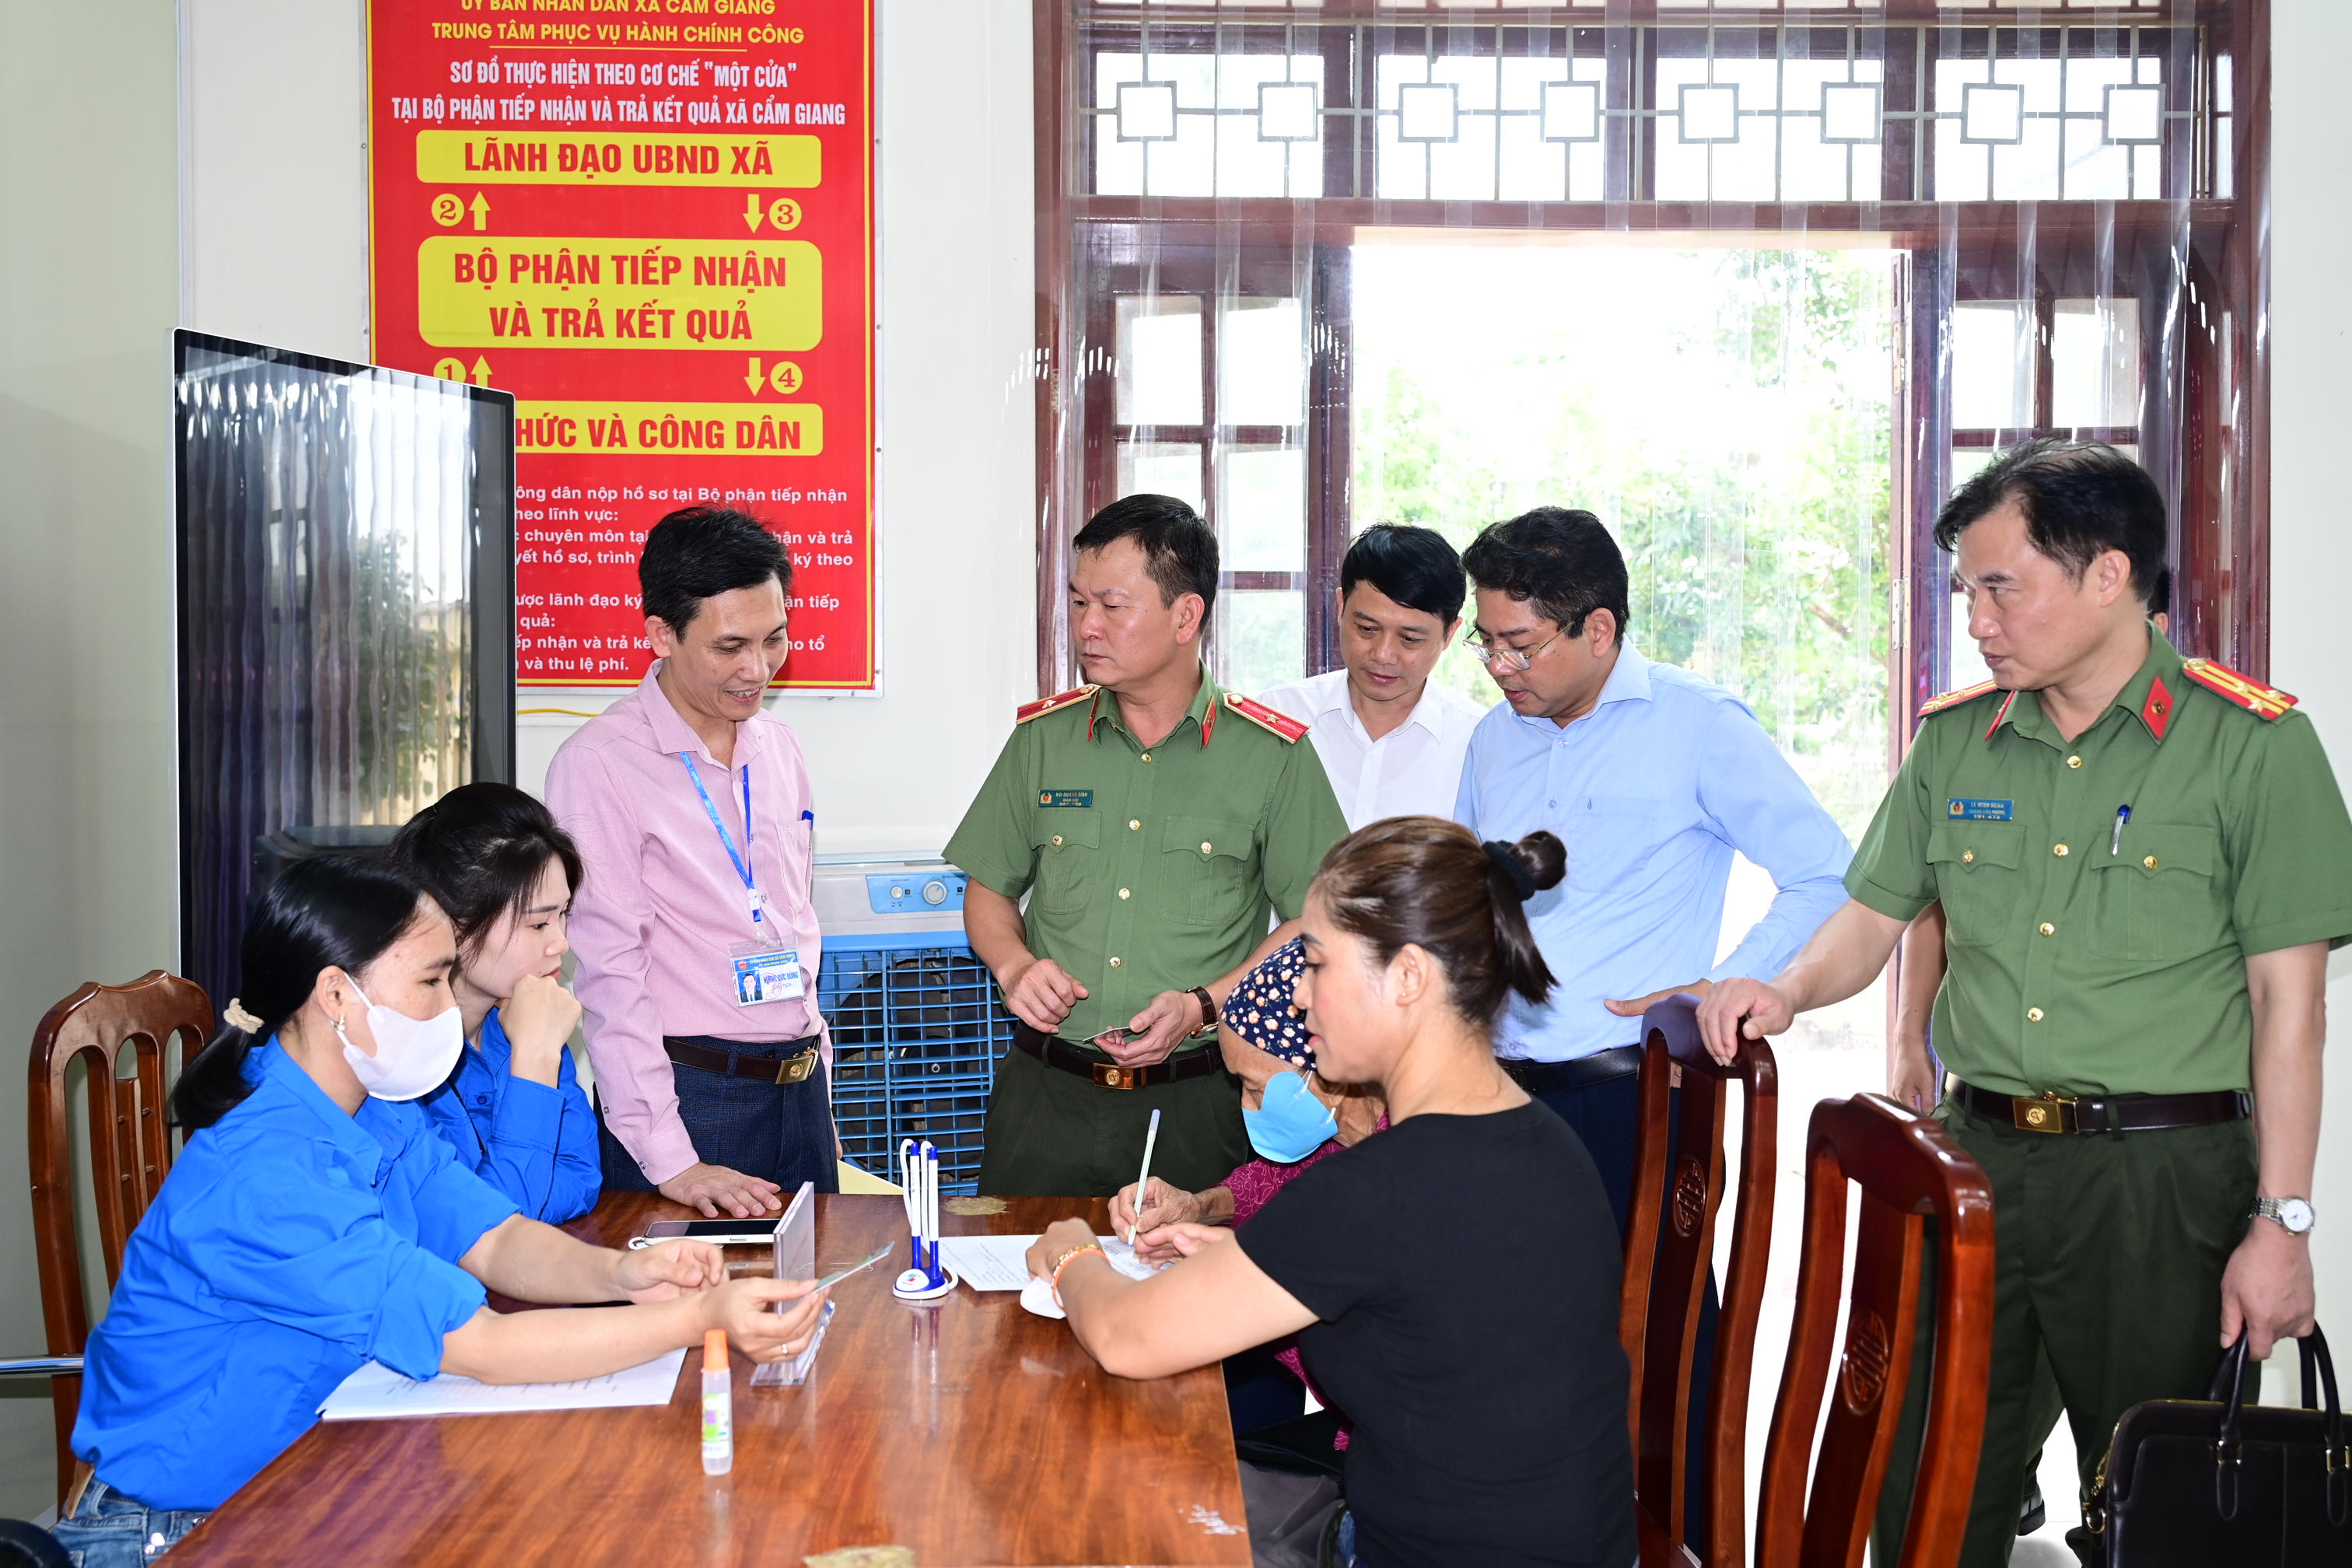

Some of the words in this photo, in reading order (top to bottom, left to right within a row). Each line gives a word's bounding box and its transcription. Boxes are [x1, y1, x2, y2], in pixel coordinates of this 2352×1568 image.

[714, 0, 775, 15] GIANG
[432, 22, 492, 40] TRUNG
[497, 19, 535, 40] TÂM
[541, 23, 591, 44] PHỤC
[596, 24, 621, 45] VỤ
[626, 20, 678, 42] HÀNH
[683, 22, 742, 43] CHÍNH
[747, 23, 804, 44] CÔNG
[450, 59, 473, 83] SƠ
[476, 54, 499, 84] ĐỒ
[503, 60, 547, 89] THỰC
[551, 58, 590, 89] HIỆN
[594, 63, 636, 86] THEO
[640, 61, 663, 86] CƠ
[667, 58, 701, 86] CHẾ
[391, 97, 418, 123] TẠI
[422, 93, 445, 123] BỘ
[450, 94, 495, 124] PHẬN
[499, 92, 536, 121] TIẾP
[540, 95, 587, 126] NHẬN
[591, 95, 613, 121] VÀ
[617, 93, 649, 122] TRẢ
[653, 94, 684, 123] KẾT
[688, 94, 722, 125] QUẢ
[725, 98, 748, 124] XÃ
[752, 94, 790, 124] CẨM
[794, 103, 845, 125] GIANG
[464, 137, 548, 172] LÃNH
[557, 143, 621, 180] ĐẠO
[633, 144, 719, 174] UBND
[730, 140, 773, 175] XÃ
[439, 199, 457, 221] 2
[777, 204, 794, 225] 3
[454, 247, 498, 290] BỘ
[509, 247, 600, 292] PHẬN
[611, 245, 682, 285] TIẾP
[694, 250, 786, 293] NHẬN
[488, 300, 532, 338] VÀ
[541, 298, 605, 338] TRẢ
[616, 299, 675, 339] KẾT
[686, 299, 753, 343] QUẢ
[443, 364, 453, 380] 1
[778, 368, 796, 387] 4
[515, 412, 576, 447] HỨC
[587, 413, 628, 448] VÀ
[639, 413, 724, 449] CÔNG
[736, 415, 800, 450] DÂN
[516, 485, 546, 502] ông
[551, 486, 582, 499] dân
[587, 486, 618, 502] nộp
[623, 485, 644, 500] hồ
[648, 488, 669, 500] sơ
[672, 488, 693, 503] tại
[698, 487, 721, 503] Bộ
[725, 488, 766, 504] phận
[770, 486, 802, 505] tiếp
[807, 488, 847, 504] nhận
[516, 508, 544, 520] heo
[548, 507, 579, 520] lĩnh
[584, 509, 618, 523] vực:
[524, 528, 583, 545] chuyên
[589, 529, 625, 542] môn
[772, 530, 802, 547] hận
[807, 530, 826, 544] và
[831, 530, 853, 544] trả
[516, 548, 537, 565] yết
[543, 548, 564, 563] hồ
[568, 551, 592, 565] sơ,
[597, 550, 635, 564] trình
[793, 552, 812, 569] ký
[816, 552, 853, 566] theo
[516, 593, 544, 608] ược
[549, 593, 584, 606] lãnh
[589, 593, 621, 609] đạo
[625, 593, 642, 610] ký
[785, 595, 803, 608] ận
[808, 593, 840, 611] tiếp
[520, 612, 555, 630] quả:
[516, 633, 532, 651] ếp
[537, 635, 577, 651] nhận
[583, 635, 601, 649] và
[606, 635, 628, 649] trả
[808, 634, 825, 651] tổ
[524, 656, 543, 670] và
[548, 657, 575, 670] thu
[579, 656, 594, 673] lệ
[599, 657, 629, 674] phí.
